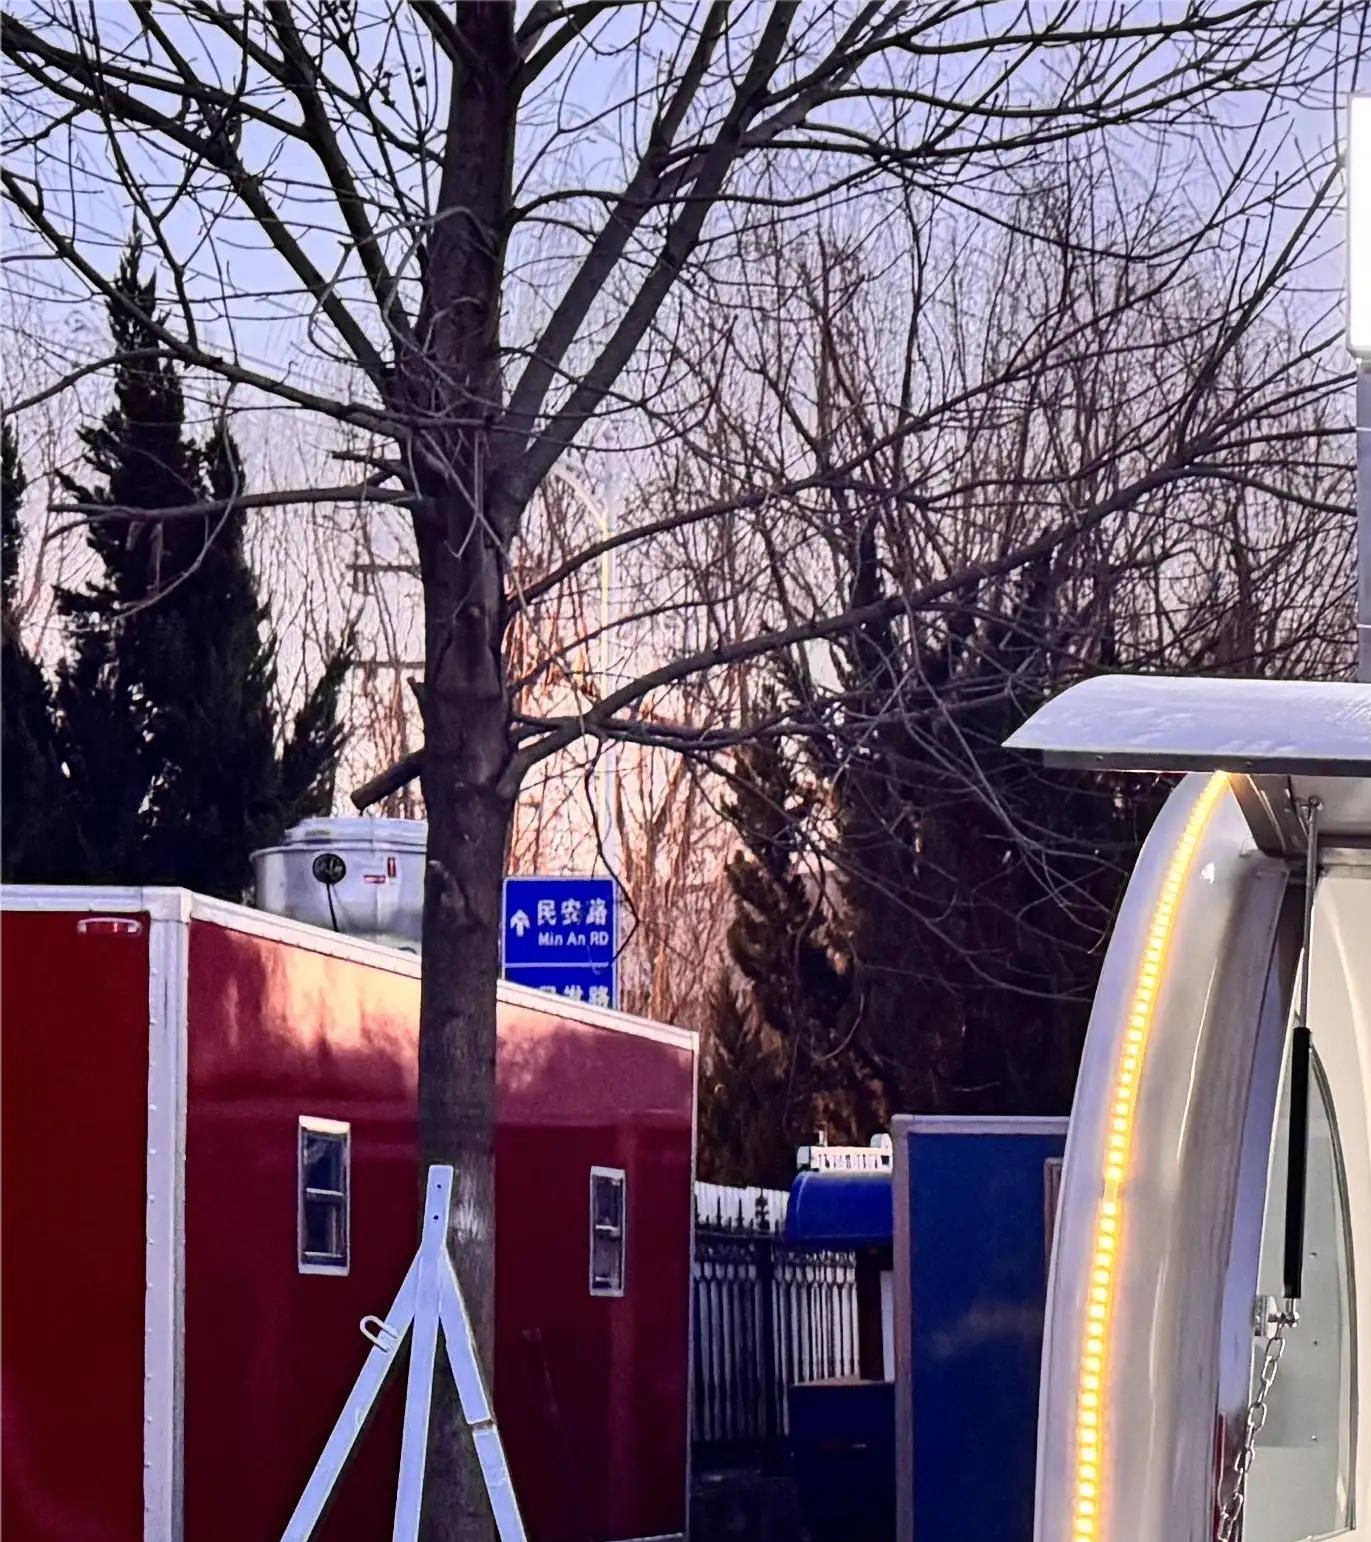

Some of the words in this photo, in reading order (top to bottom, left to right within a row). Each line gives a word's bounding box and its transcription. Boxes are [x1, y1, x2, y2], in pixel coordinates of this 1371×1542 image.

[537, 898, 608, 926] 民安路
[538, 931, 563, 946] Min
[566, 931, 586, 946] An
[590, 931, 609, 946] RD
